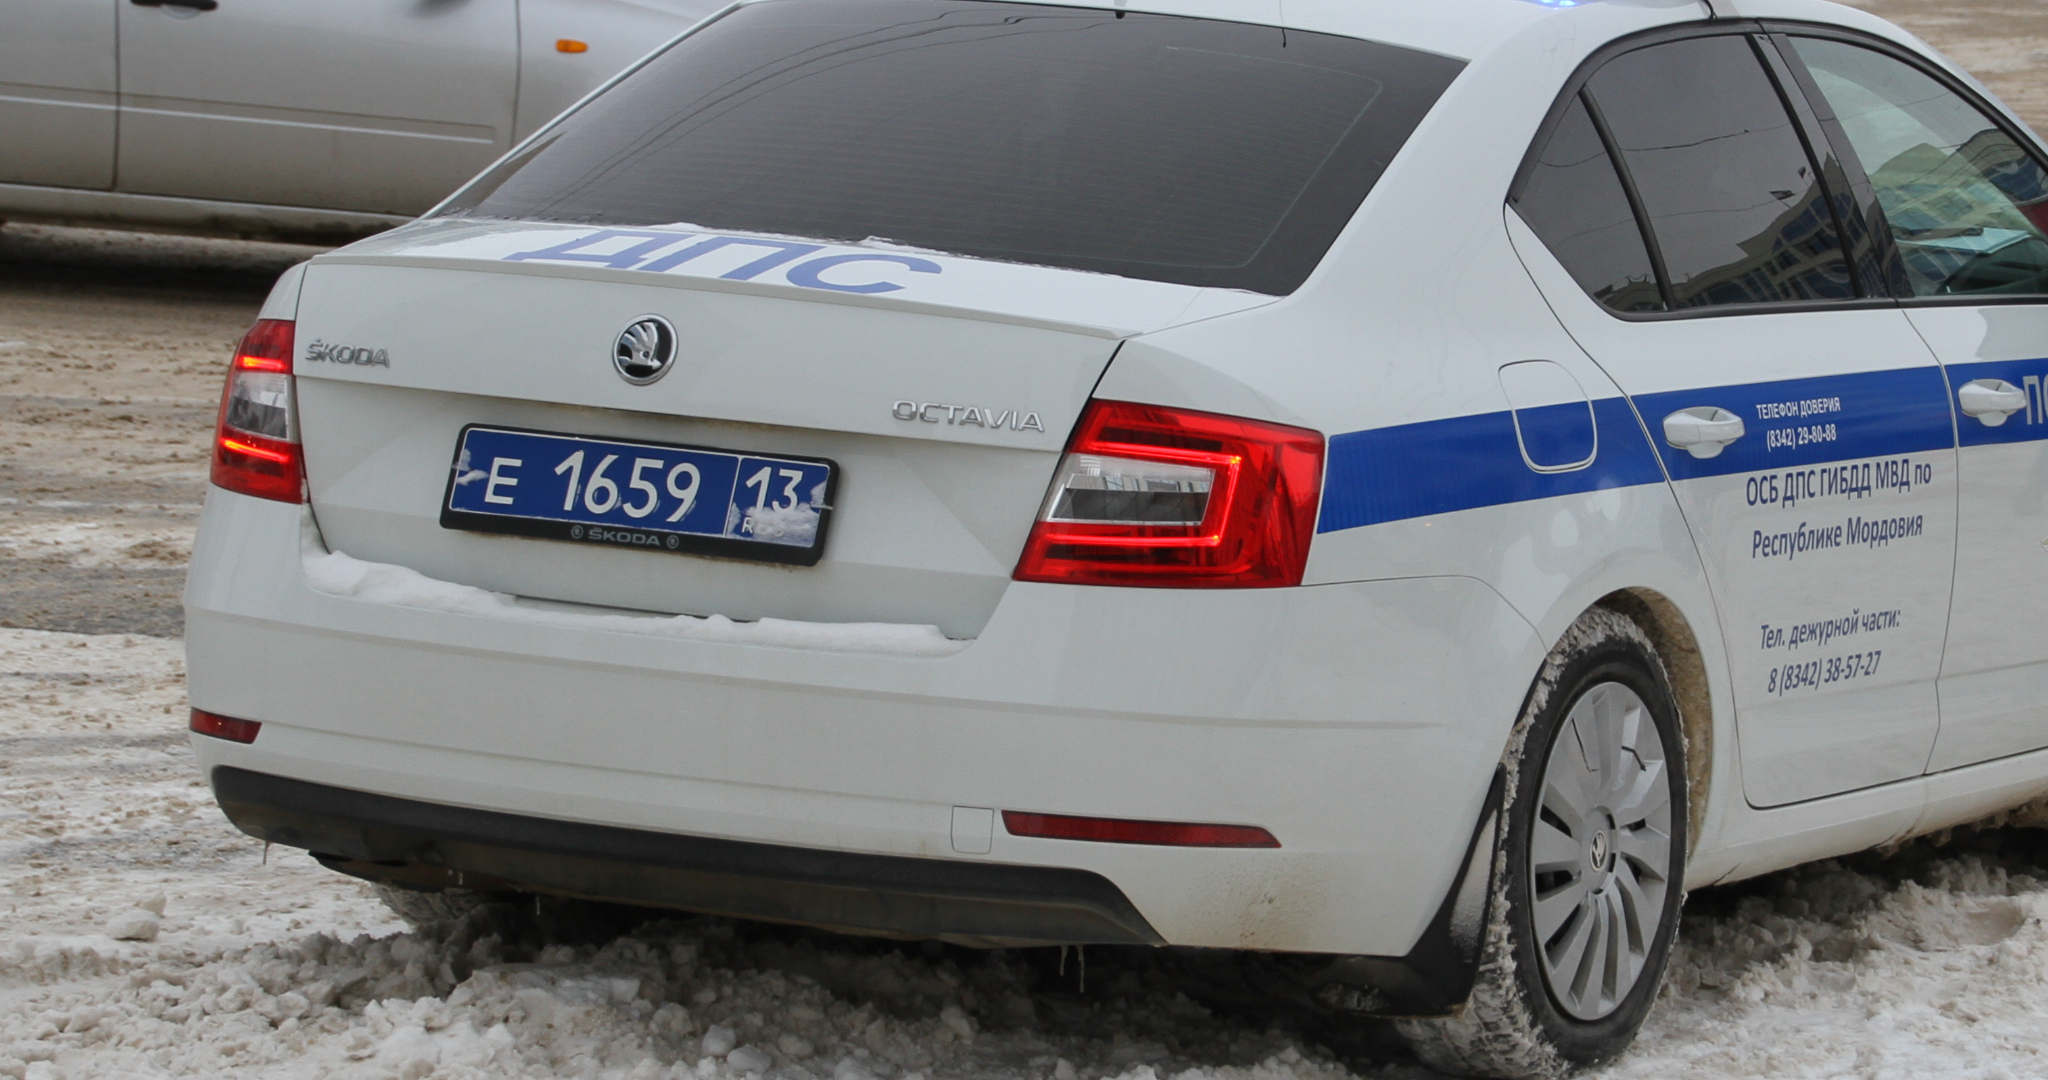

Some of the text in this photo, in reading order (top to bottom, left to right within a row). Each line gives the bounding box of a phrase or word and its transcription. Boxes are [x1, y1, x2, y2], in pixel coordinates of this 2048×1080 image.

[502, 230, 943, 294] ДПС
[305, 339, 390, 368] ŠKODA
[892, 400, 1045, 433] OCTAVIA
[1756, 397, 1841, 420] ТЕЛЕФОН ДОВЕРИЯ
[1767, 424, 1837, 452] (8342) 29-80-88
[554, 450, 701, 523] 1659
[745, 466, 804, 513] 13
[1746, 458, 1932, 508] ОСБ ДПС ГИБДД МВД по
[588, 527, 661, 546] ŠKODA
[1752, 514, 1923, 561] Республике Мордовия
[1760, 607, 1901, 650] Тел. дежурной части:
[1767, 650, 1882, 697] 8 (8342) 38-57-27
